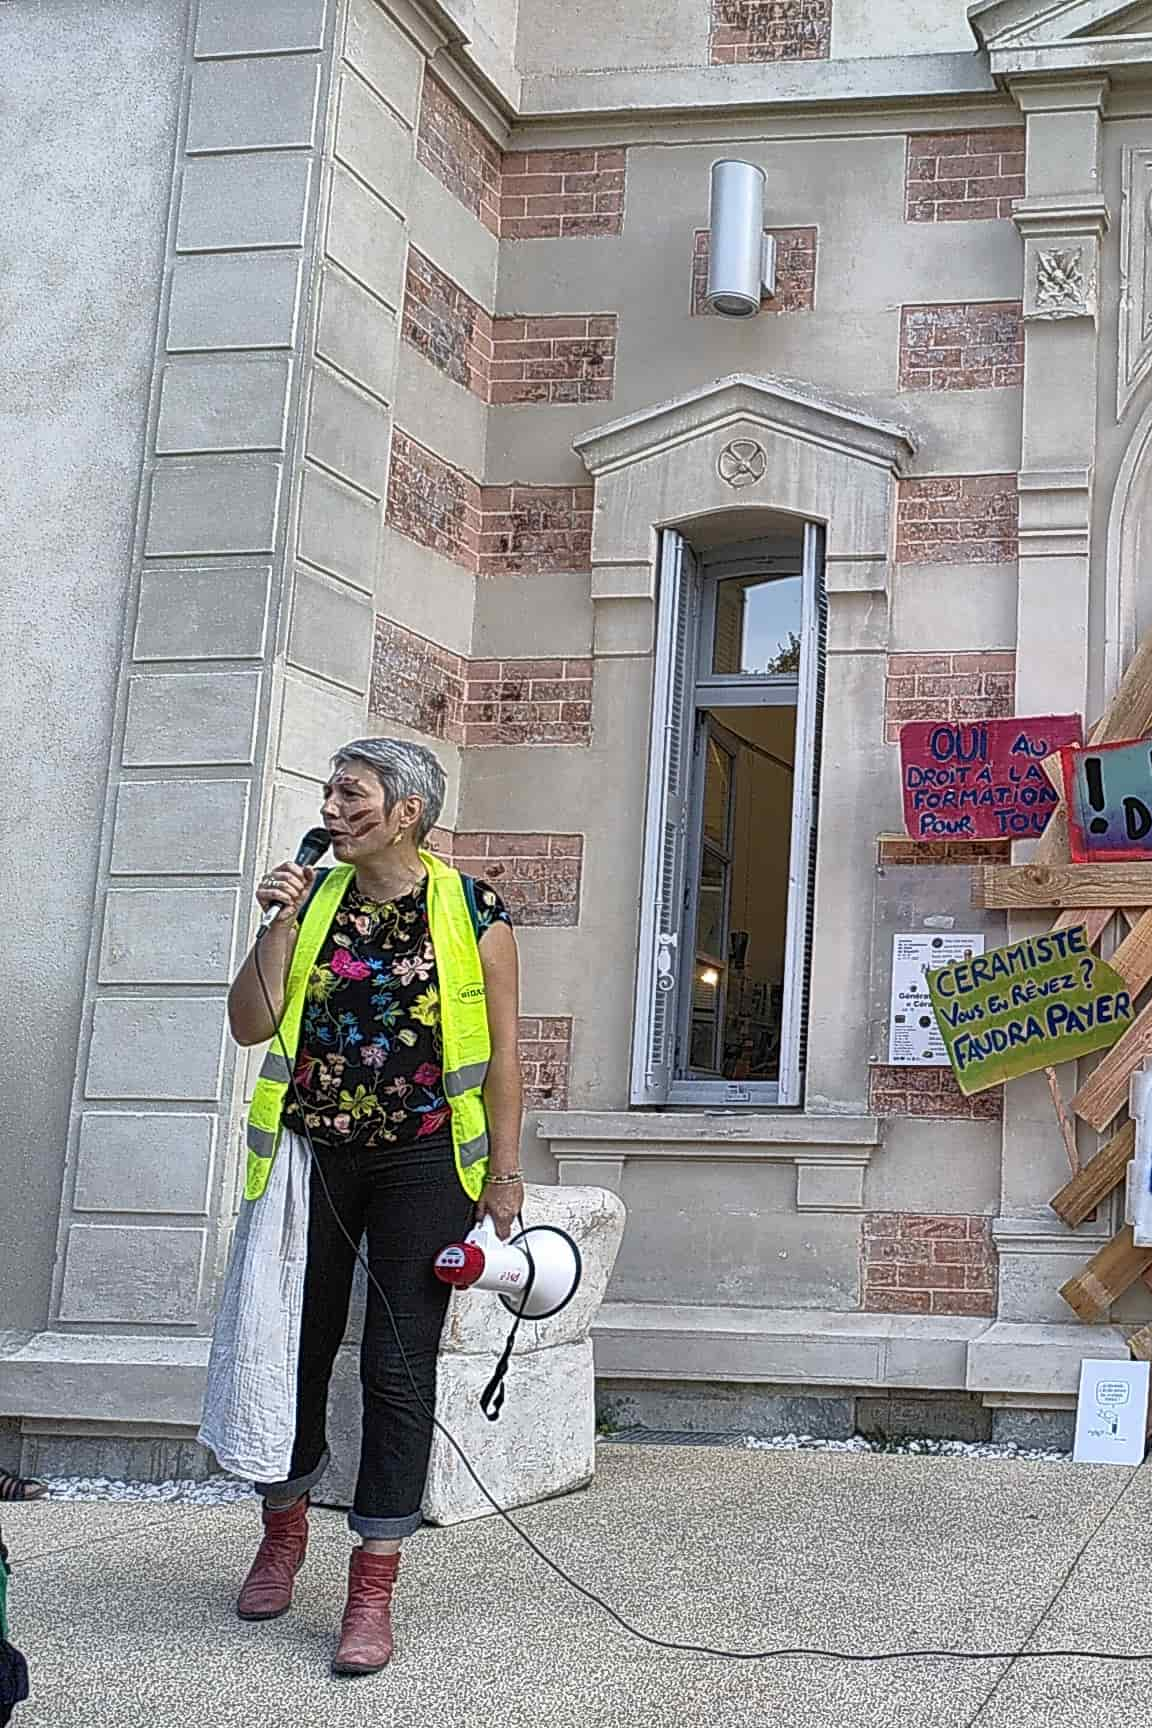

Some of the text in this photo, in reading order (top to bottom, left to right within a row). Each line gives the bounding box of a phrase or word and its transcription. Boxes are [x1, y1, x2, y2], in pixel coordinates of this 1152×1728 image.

[931, 727, 1048, 761] OUI AU
[907, 766, 971, 787] DROIT
[1009, 765, 1043, 782] LA
[913, 786, 1060, 810] FORMATION
[920, 812, 975, 835] POUR
[936, 925, 1087, 998] CERAMISTE
[1011, 973, 1079, 1007] RÊVEZ
[1079, 958, 1094, 989] ?
[953, 1016, 1045, 1070] FAUDRA
[1046, 992, 1131, 1037] PAYER
